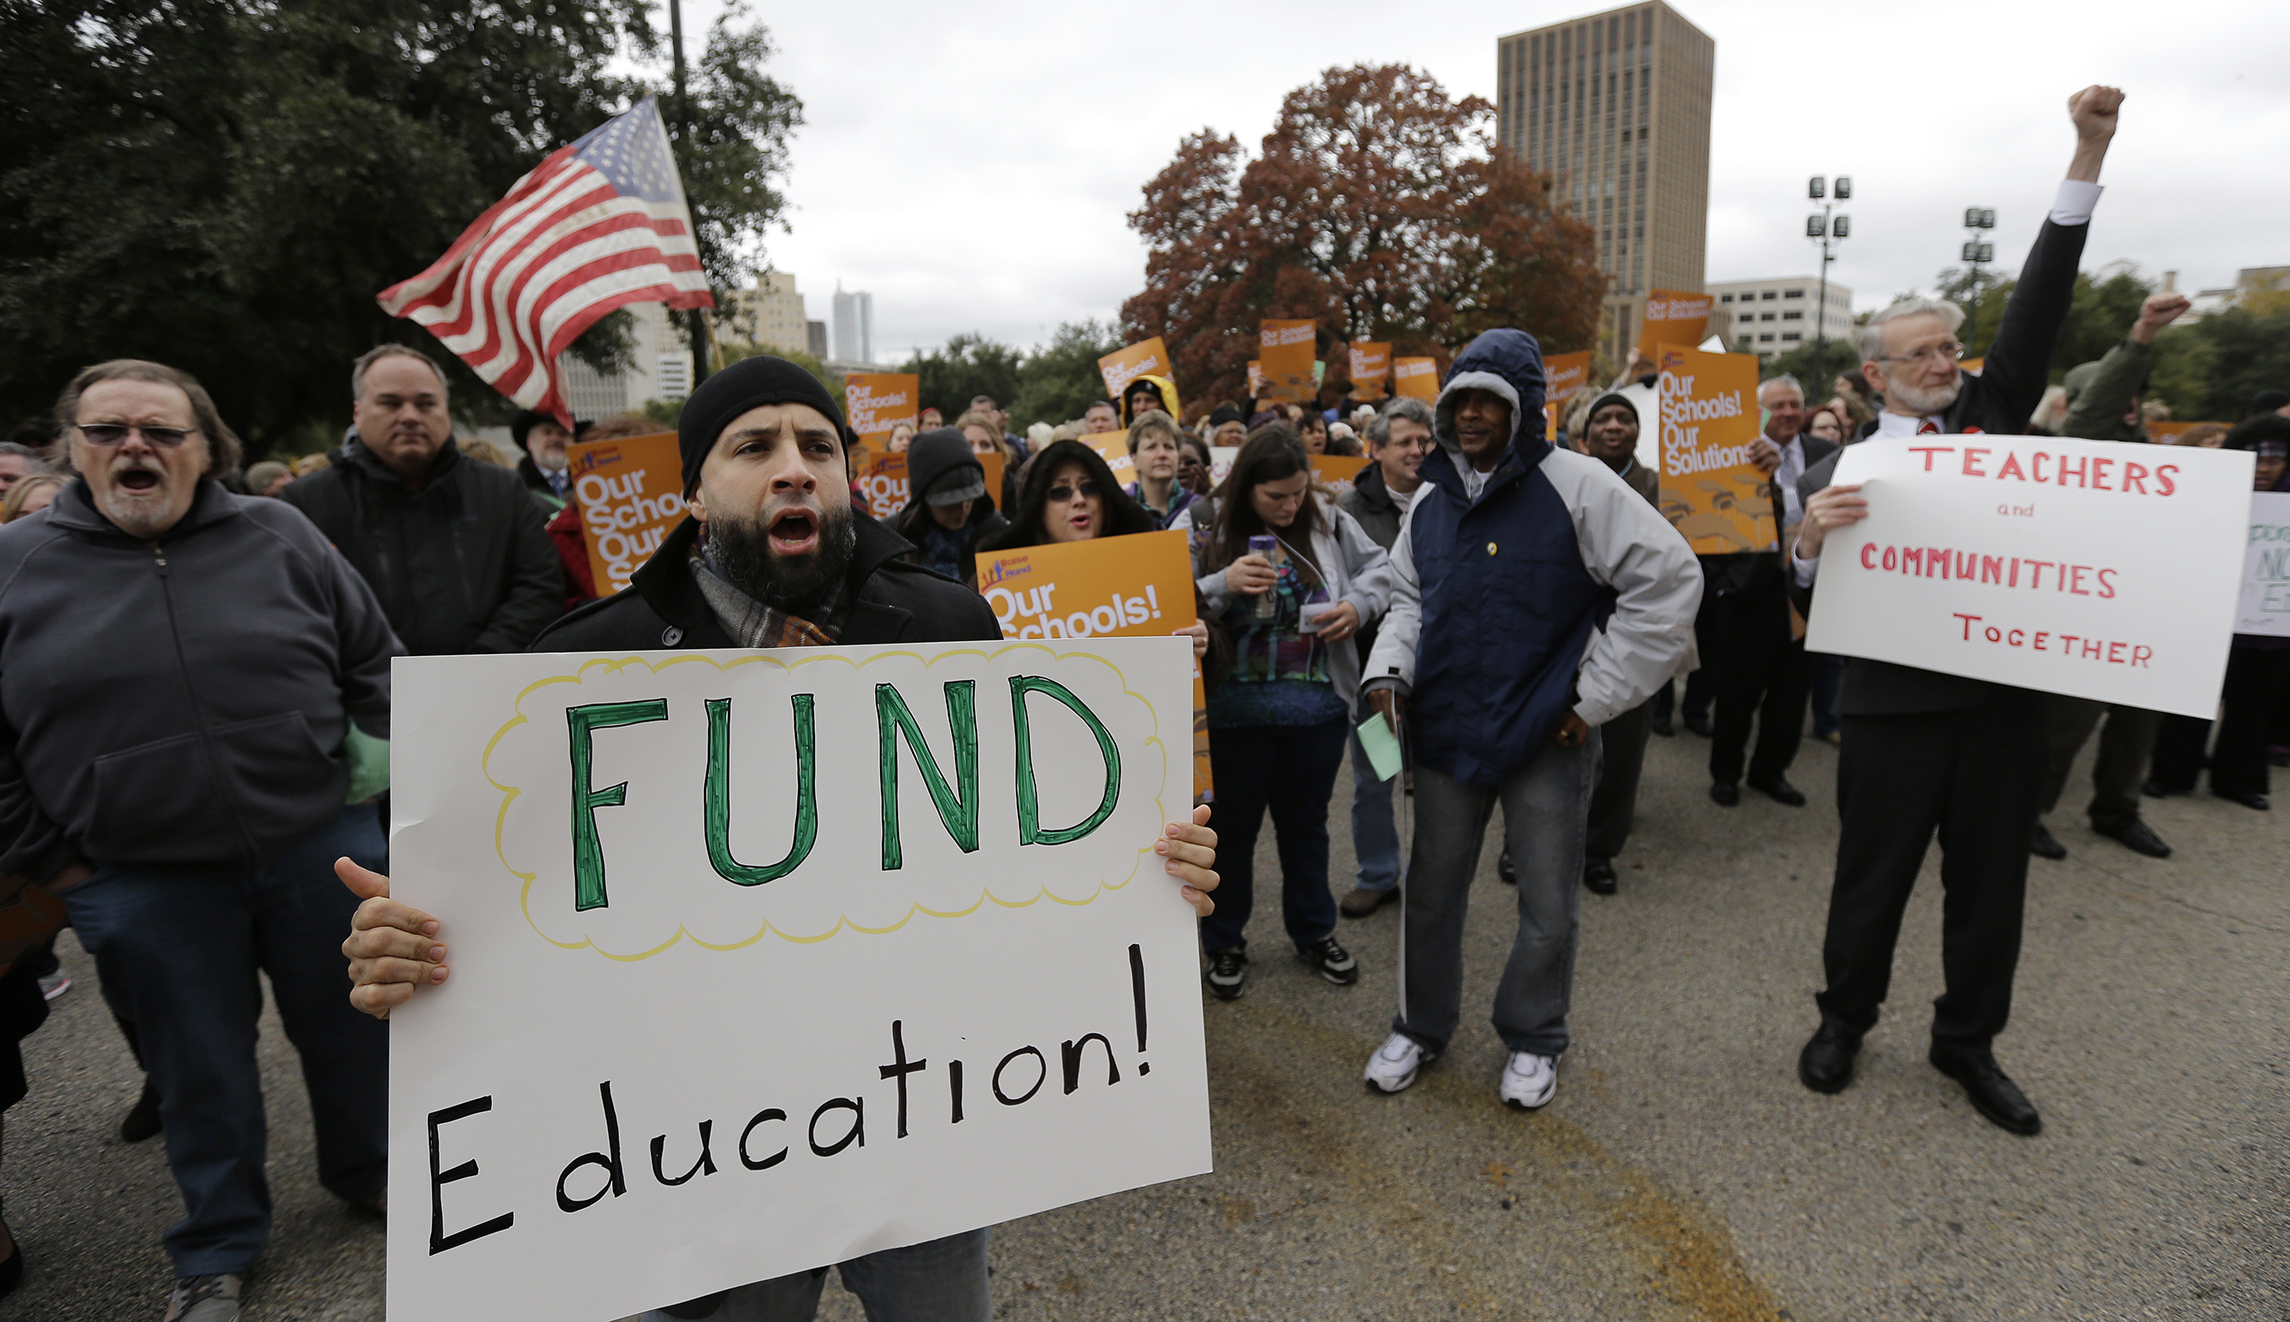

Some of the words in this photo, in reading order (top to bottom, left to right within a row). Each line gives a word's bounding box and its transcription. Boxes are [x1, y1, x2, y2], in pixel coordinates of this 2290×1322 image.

[846, 385, 872, 399] Our
[1660, 371, 1695, 398] Our
[1661, 389, 1743, 424] Schools!
[1663, 422, 1700, 450] Our
[576, 469, 646, 507] Our
[1908, 447, 2180, 497] TEACHERS
[1998, 503, 2034, 518] and
[598, 525, 665, 563] Our
[1000, 555, 1028, 568] Raise
[1860, 542, 2119, 599] COMMUNITIES
[983, 582, 1056, 623] Our
[566, 675, 1121, 912] FUND
[428, 943, 1151, 1256] Education!
